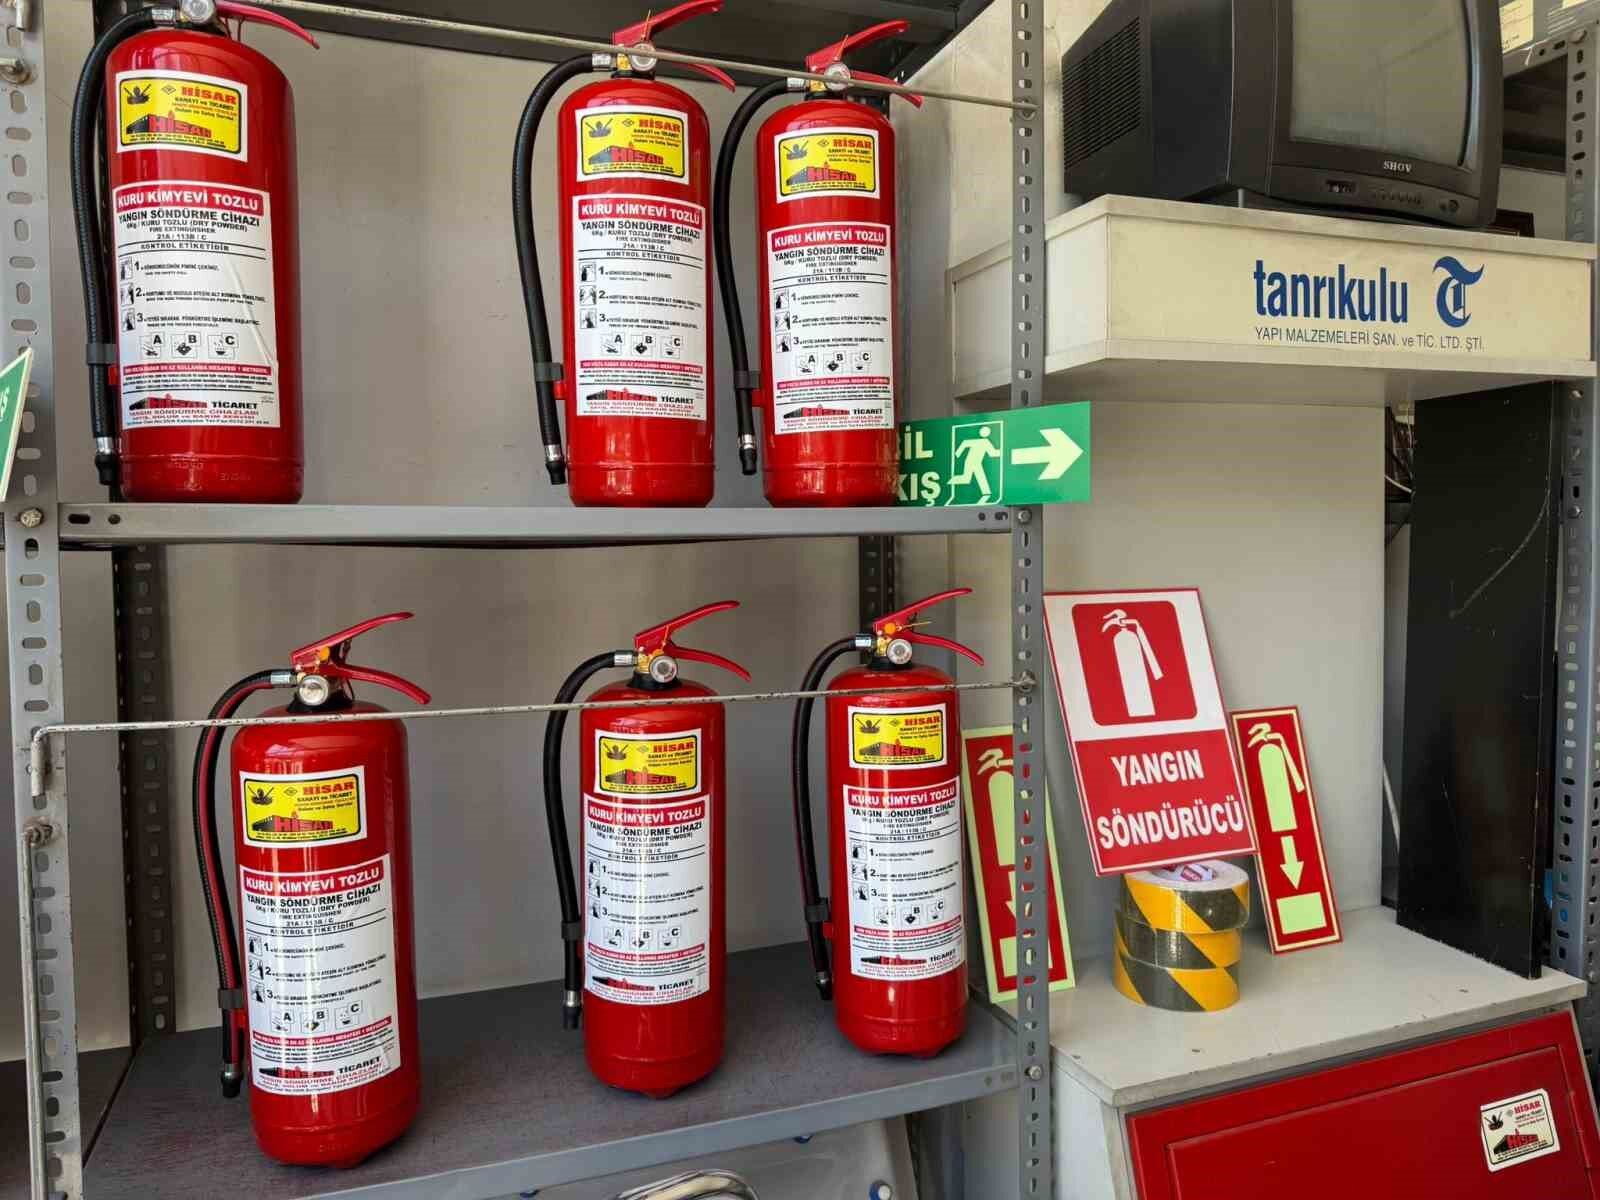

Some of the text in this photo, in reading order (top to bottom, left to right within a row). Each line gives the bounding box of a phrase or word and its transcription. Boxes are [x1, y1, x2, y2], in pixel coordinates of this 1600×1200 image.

[182, 86, 236, 104] HİSAR
[640, 118, 680, 132] HİSAR
[833, 139, 872, 149] HİSAR
[118, 190, 258, 210] KURU KİMYEVİ TOZLU
[118, 208, 260, 226] YANGIN SÖNDÜRME CİHAZI
[582, 203, 700, 224] KURU KİMYEVİ TOZLU
[190, 220, 209, 228] (DRY
[211, 220, 248, 232] POWDER)
[582, 220, 700, 239] YANGIN SÖNDÜRME CİHAZI
[775, 230, 884, 247] KURU KİMYEVİ TOZLU
[775, 246, 884, 260] YANGIN SÖNDÜRME CİHAZI
[1254, 260, 1408, 323] tanrıkulu
[154, 334, 235, 345] A B C
[614, 334, 622, 343] A
[645, 336, 652, 344] B
[1255, 327, 1282, 341] YAPI
[1286, 328, 1370, 345] MALZEMELERİ
[1402, 336, 1414, 346] ve
[1416, 334, 1438, 348] TİC.
[1440, 335, 1463, 349] LTD.
[212, 402, 258, 410] TİCARET
[653, 742, 694, 753] HİSAR
[1110, 748, 1204, 786] YANGIN
[303, 782, 354, 795] HİSAR
[851, 788, 955, 806] KURU KİMYEVİ TOZLU
[590, 806, 702, 823] KURU KİMYEVİ TOZLU
[1097, 796, 1244, 850] SÖNDÜRÜCÜ
[590, 821, 615, 833] YANGIN
[673, 822, 702, 834] CİHAZI
[246, 868, 379, 892] KURU KİMYEVİ TOZLU
[248, 885, 381, 907] YANGIN SÖNDÜRME CİHAZI
[930, 948, 956, 962] TİCARET
[659, 978, 694, 990] TİCARET
[284, 1004, 360, 1022] A B C
[339, 1056, 382, 1074] TİCARET
[1514, 1100, 1541, 1114] HİSAR
